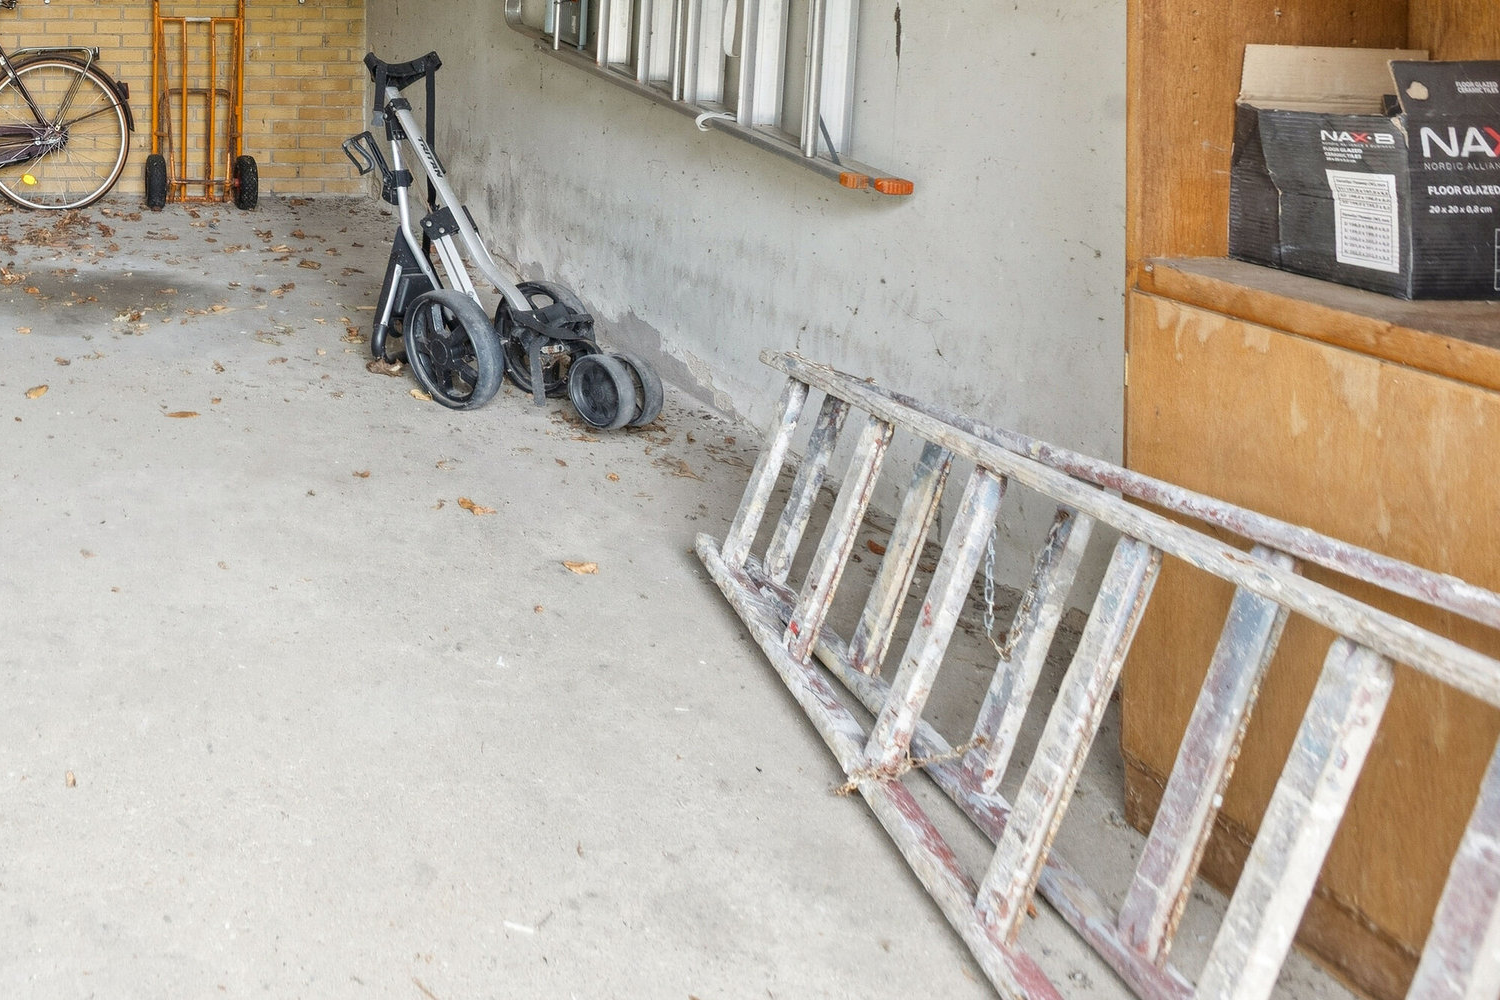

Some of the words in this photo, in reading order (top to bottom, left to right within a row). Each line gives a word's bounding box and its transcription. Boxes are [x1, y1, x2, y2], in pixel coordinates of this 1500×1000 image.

[1423, 162, 1463, 171] NORDIC
[1427, 185, 1461, 195] FLOOR
[1462, 184, 1500, 195] GLAZED
